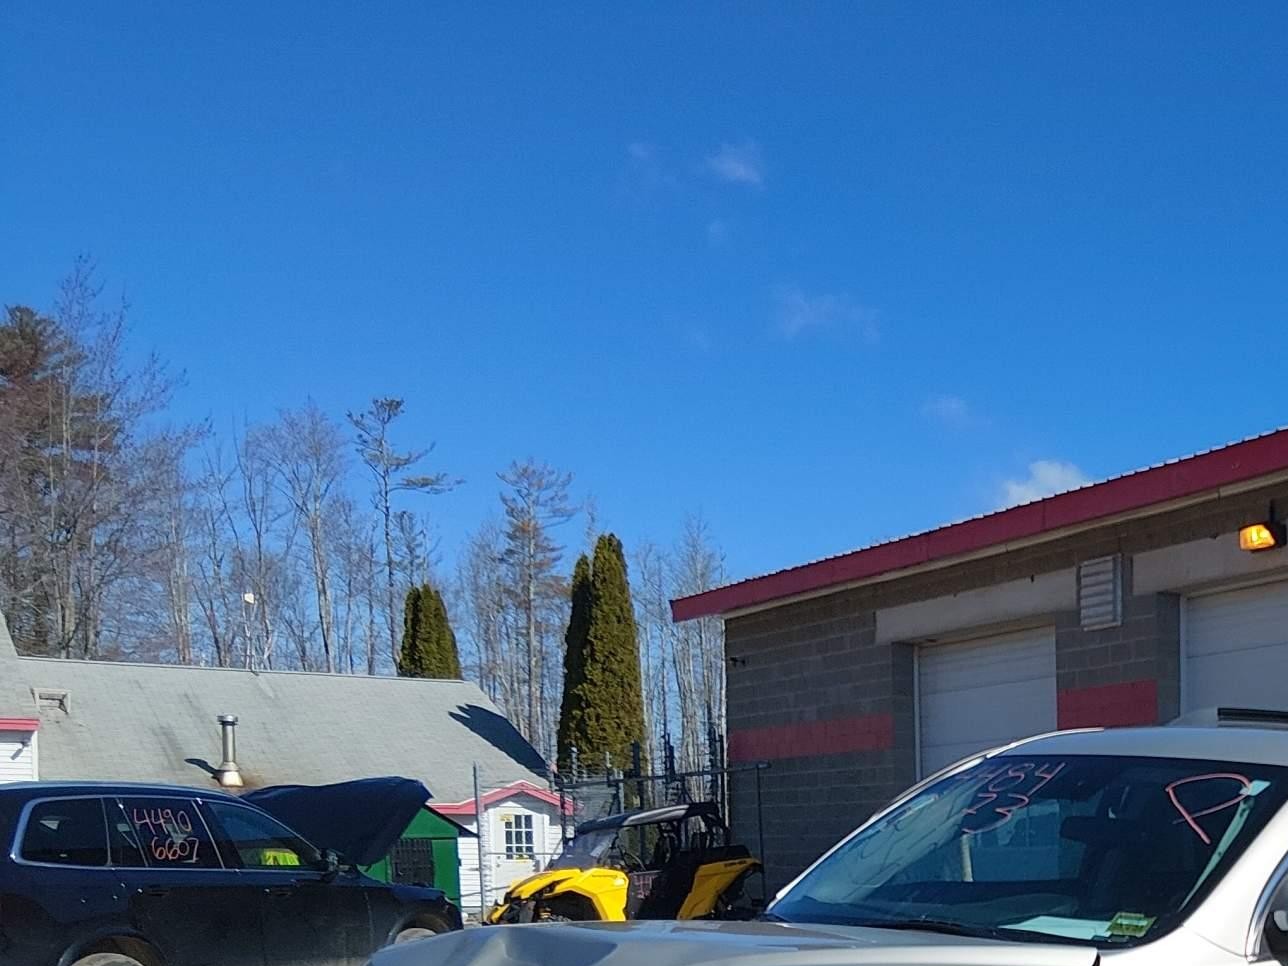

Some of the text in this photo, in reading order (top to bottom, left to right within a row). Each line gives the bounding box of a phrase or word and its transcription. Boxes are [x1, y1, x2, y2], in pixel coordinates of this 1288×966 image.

[133, 808, 192, 835] 4490
[1165, 773, 1251, 844] P
[151, 836, 199, 863] 6607
